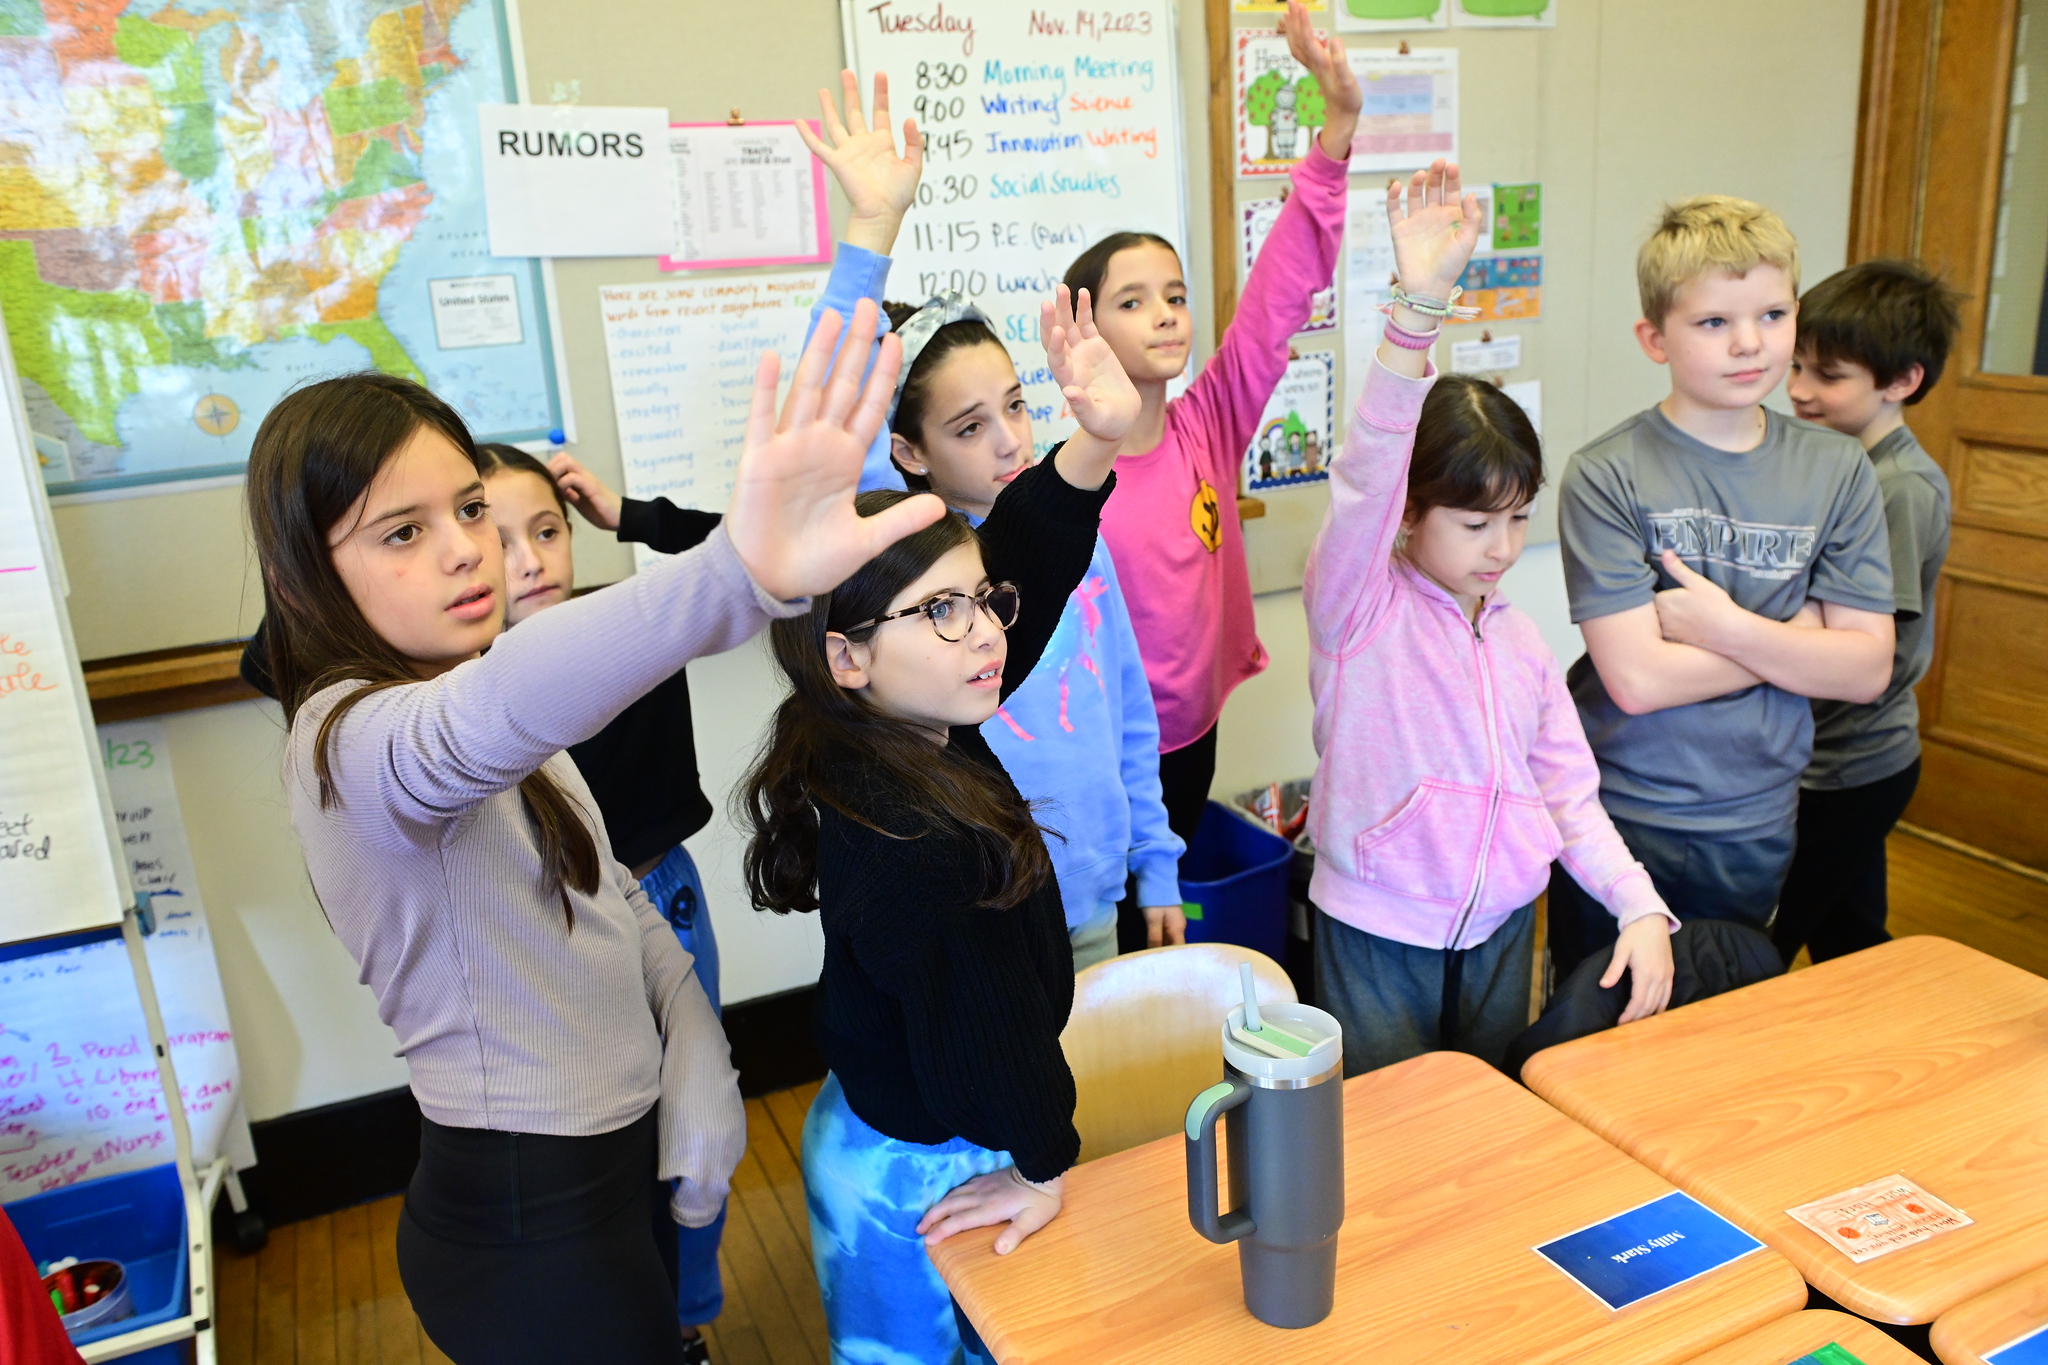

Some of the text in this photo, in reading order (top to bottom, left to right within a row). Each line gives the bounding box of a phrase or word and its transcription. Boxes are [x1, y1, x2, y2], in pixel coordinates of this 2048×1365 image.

[868, 1, 977, 57] Tuesday
[1028, 9, 1069, 36] Nov.
[915, 55, 1154, 99] 8:30 Morning Meeting
[914, 91, 1135, 125] 9:00 Writing Science
[499, 129, 644, 158] RUMORS
[985, 130, 1083, 154] Innovation
[1086, 127, 1158, 159] Writing
[989, 167, 1046, 199] Social
[1051, 166, 1122, 198] Studies
[914, 219, 981, 252] 11:15
[1031, 221, 1087, 249] (Park)
[919, 268, 987, 298] 12:00
[438, 294, 511, 309] United States
[1649, 517, 1815, 570] EMPIRE
[1610, 1229, 1687, 1265] Milly Stark
